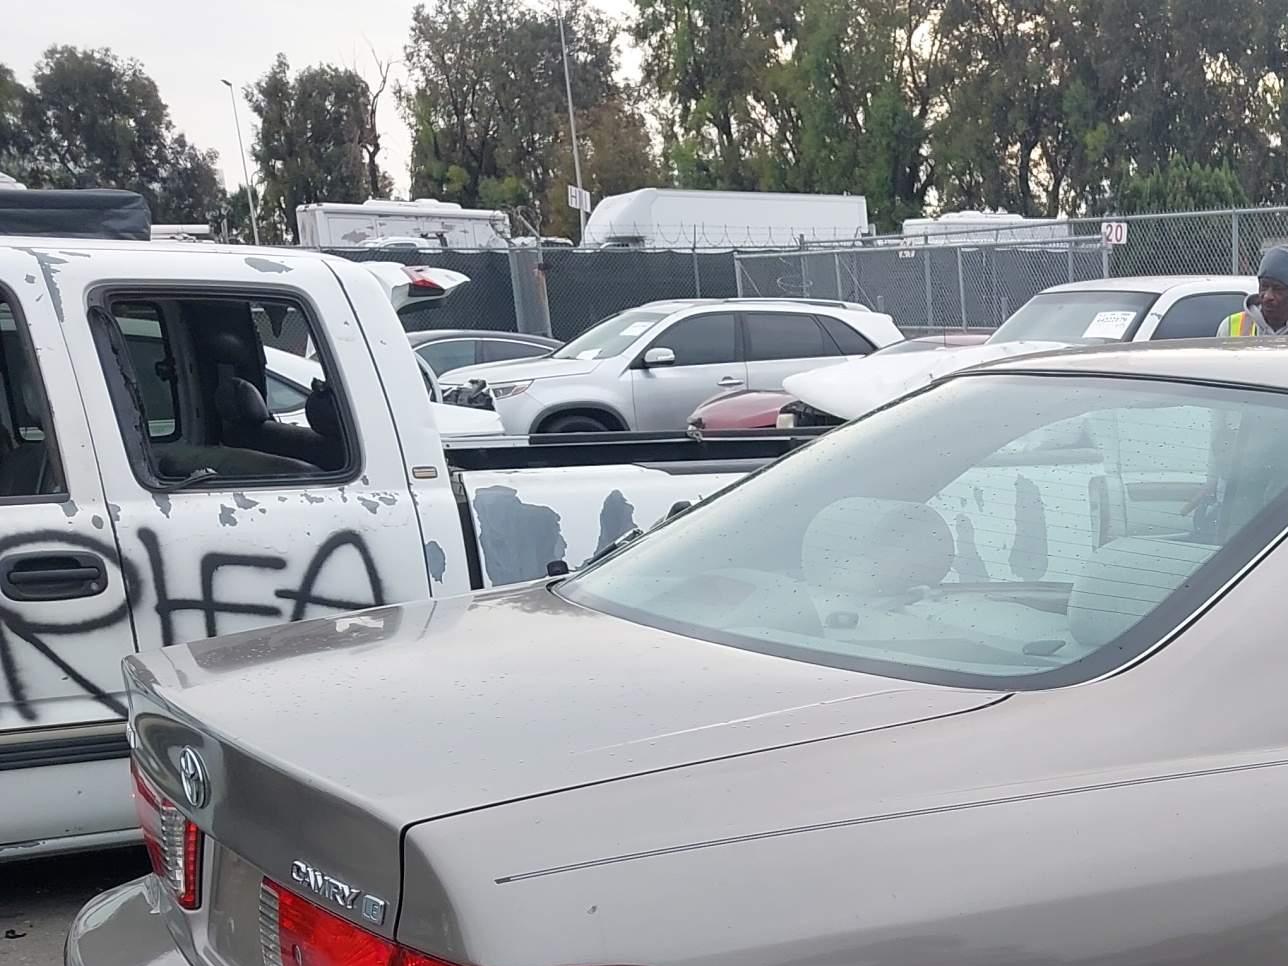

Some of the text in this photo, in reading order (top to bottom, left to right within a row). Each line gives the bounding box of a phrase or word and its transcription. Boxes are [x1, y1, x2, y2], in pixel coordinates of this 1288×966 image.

[1105, 223, 1123, 243] 20
[291, 860, 383, 923] CAMRY LE
